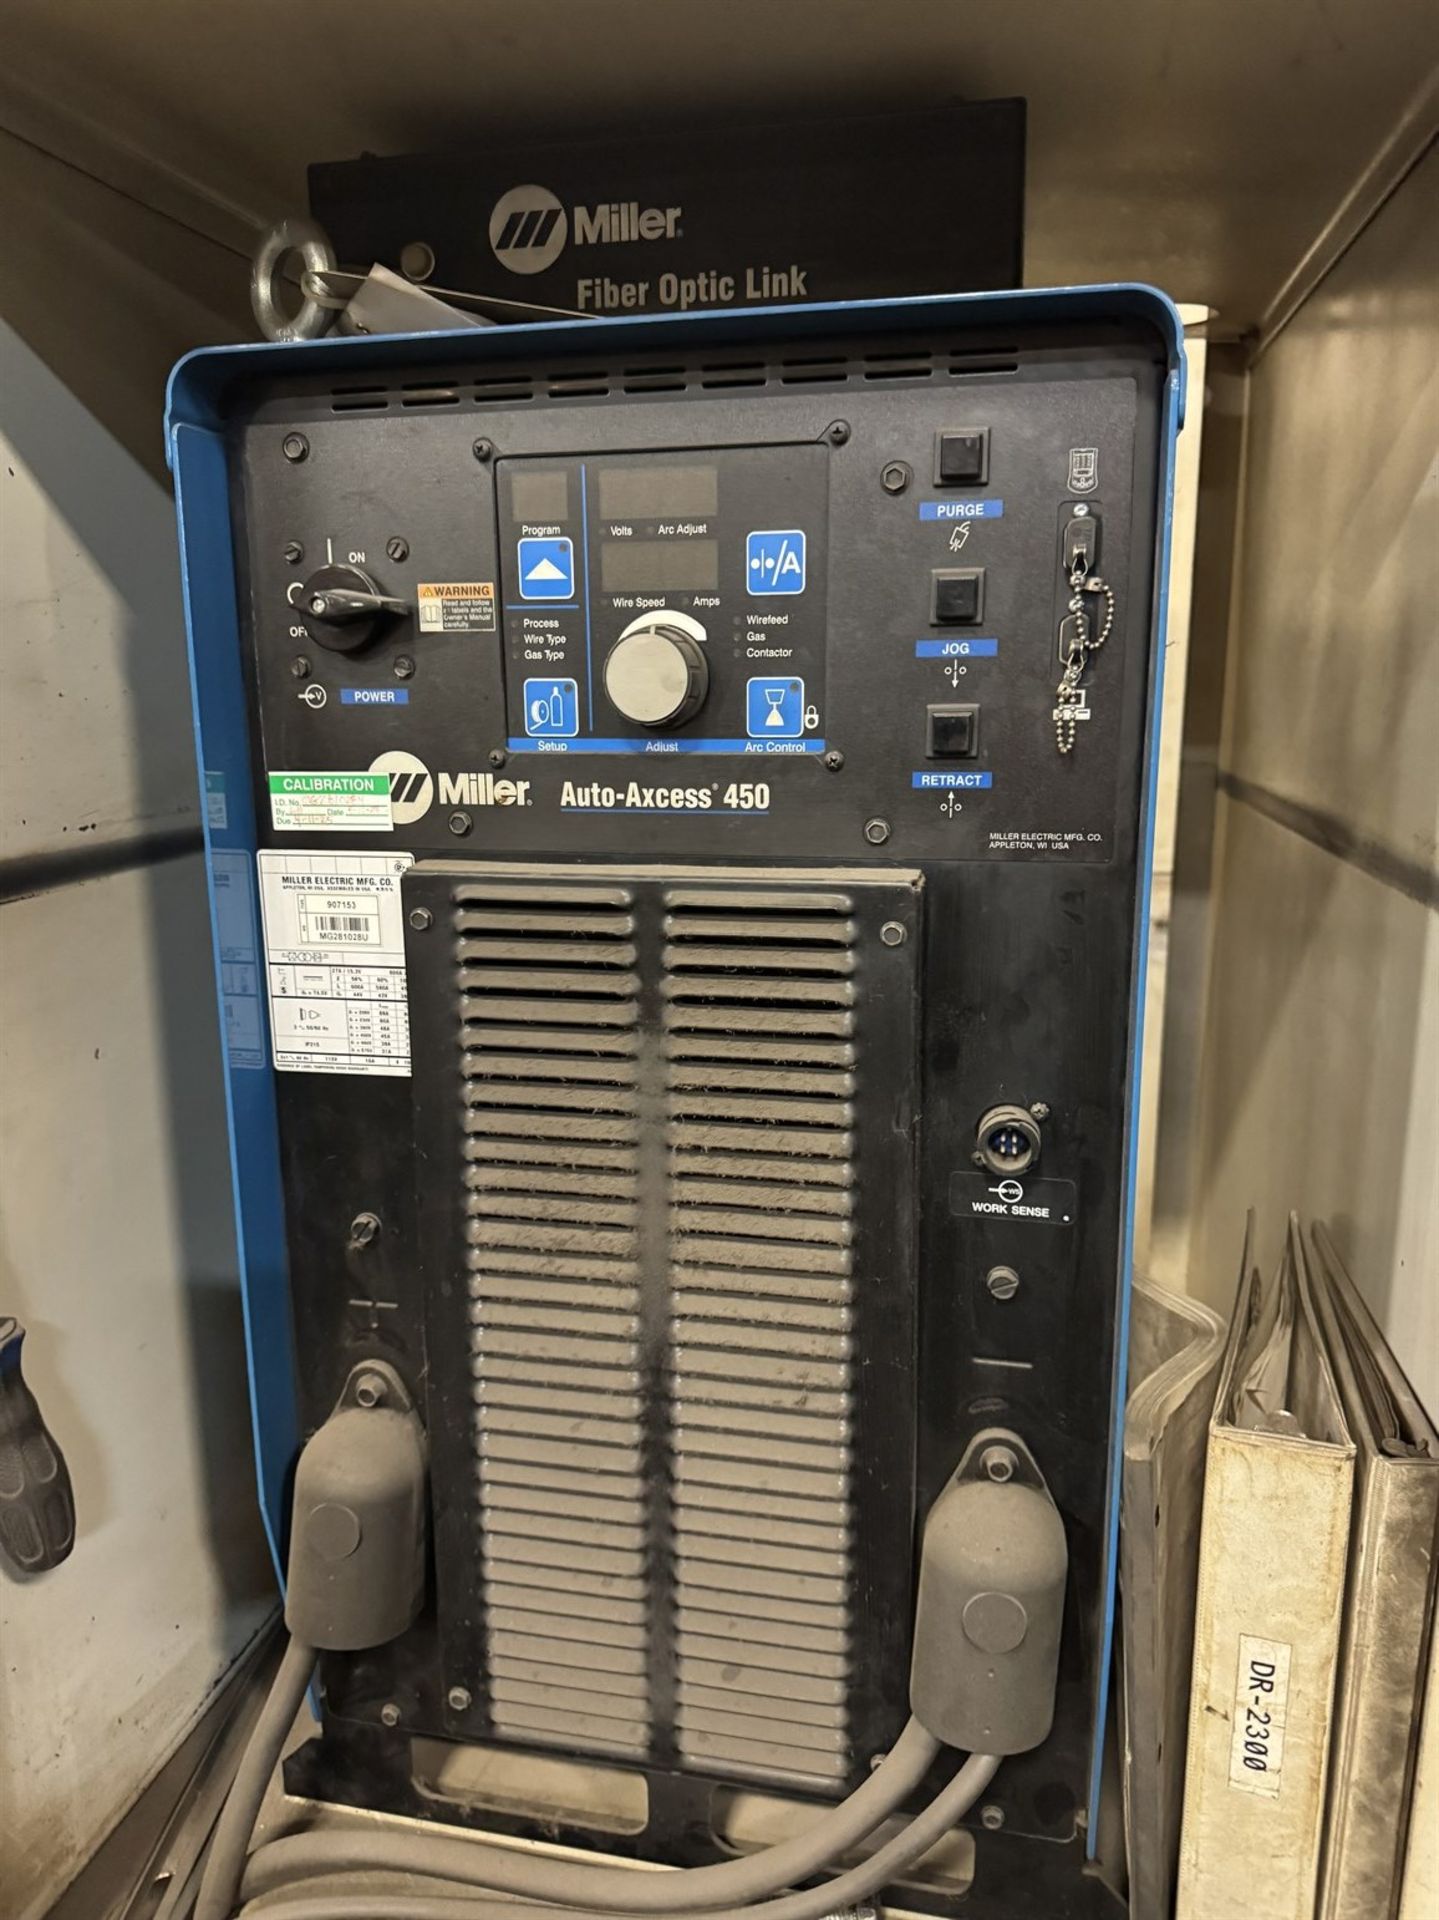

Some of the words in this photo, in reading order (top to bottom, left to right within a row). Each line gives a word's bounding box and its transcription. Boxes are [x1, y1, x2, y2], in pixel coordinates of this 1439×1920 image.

[574, 202, 682, 245] Miller
[577, 277, 650, 310] Fiber
[659, 270, 736, 310] Optic
[745, 265, 808, 299] Link
[936, 503, 985, 517] PURGE
[522, 525, 561, 537] Program
[610, 526, 633, 536] Volts
[657, 524, 675, 535] Arc
[676, 523, 708, 535] Adjust
[348, 551, 366, 563] ON
[433, 586, 490, 596] WARNING
[612, 597, 634, 608] Wire
[636, 597, 666, 609] Speed
[692, 596, 721, 608] Amps
[523, 618, 560, 629] Process
[746, 615, 789, 625] Wirefeed
[523, 634, 545, 644] Wire
[546, 634, 567, 645] Type
[746, 631, 766, 641] Gas
[746, 648, 793, 658] Contactor
[941, 642, 970, 655] JOG
[524, 650, 543, 660] Gas
[544, 650, 565, 660] Type
[354, 690, 395, 702] POWER
[537, 740, 568, 752] Setup
[645, 741, 679, 752] Adjust
[744, 741, 763, 752] Arc
[766, 741, 806, 752] Control
[282, 778, 375, 791] CALIBRATION
[921, 774, 983, 786] RETRACT
[723, 782, 770, 809] 450
[326, 808, 344, 816] Date
[276, 817, 291, 825] Due
[989, 832, 1020, 841] MILLER
[1021, 832, 1063, 841] ELECTRIC
[1064, 833, 1086, 841] MFG.
[1087, 833, 1103, 841] CO.
[988, 841, 1035, 849] APPLETON,
[1036, 841, 1048, 849] WI
[1051, 841, 1070, 849] USA
[281, 876, 313, 885] MILLER
[314, 876, 354, 885] ELECTRIC
[356, 877, 377, 886] MFG.
[379, 877, 394, 886] CO.
[326, 901, 357, 909] 907153
[971, 1202, 1008, 1214] WORK
[1011, 1205, 1050, 1218] SENSE
[1242, 1660, 1276, 1772] DR-2300
